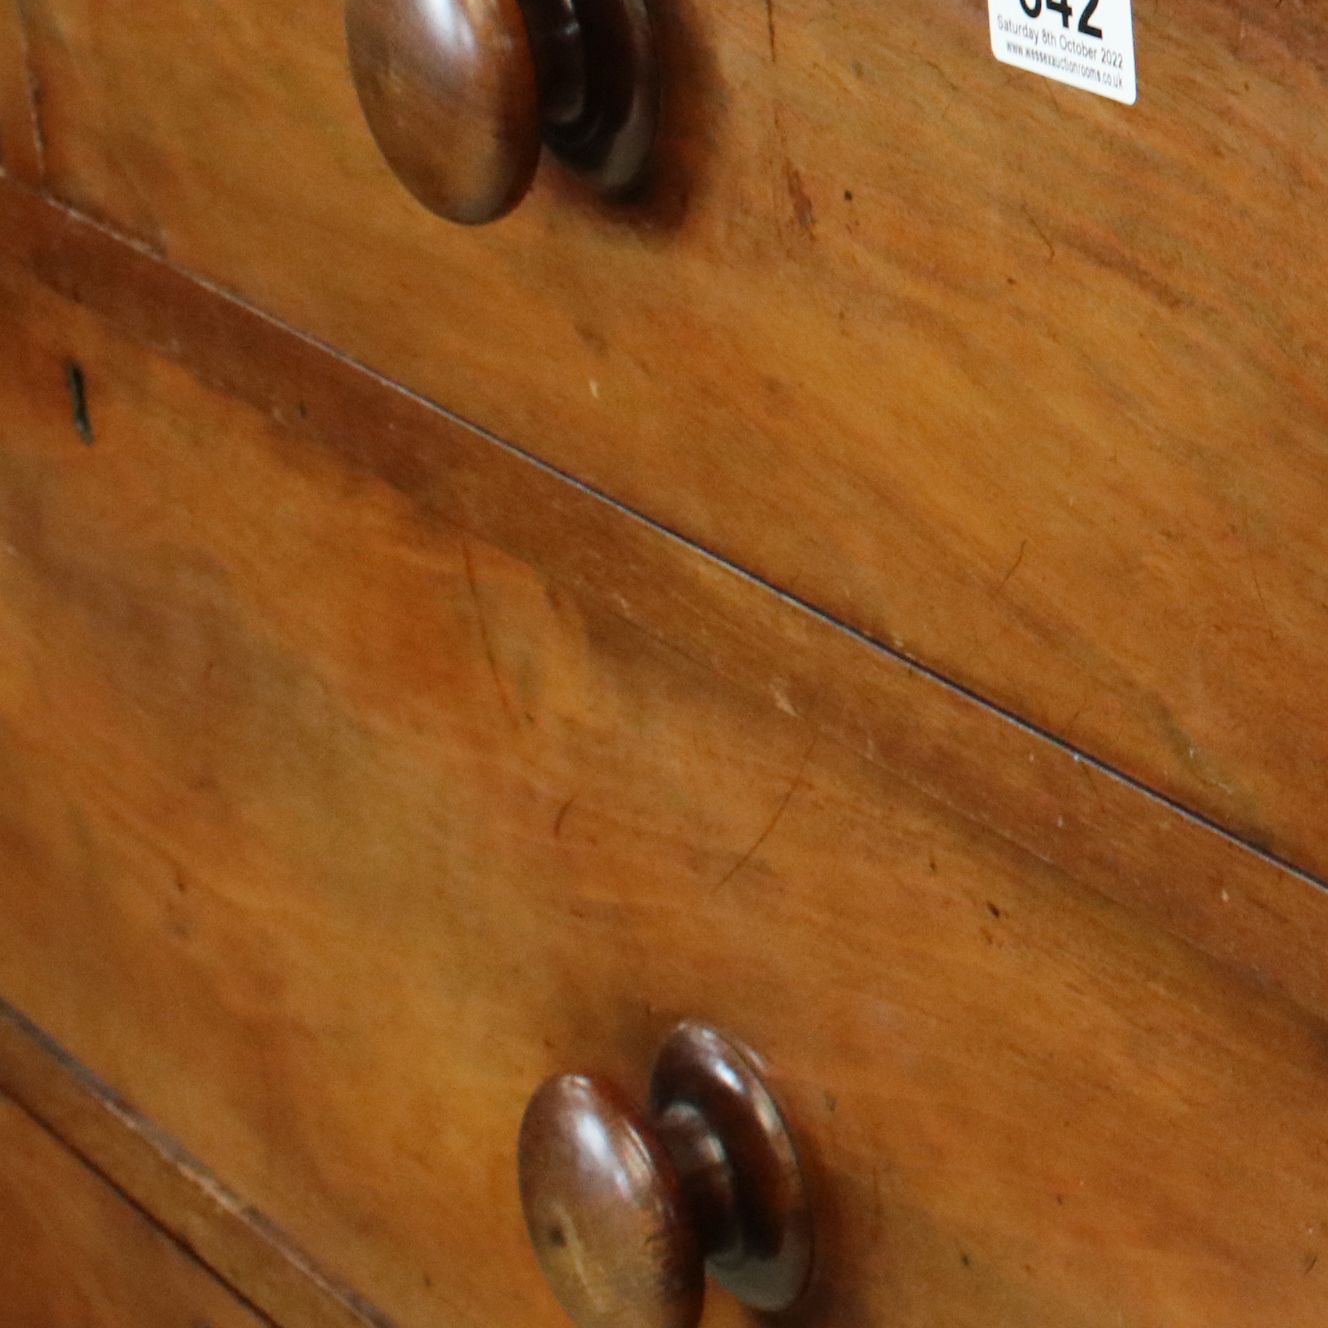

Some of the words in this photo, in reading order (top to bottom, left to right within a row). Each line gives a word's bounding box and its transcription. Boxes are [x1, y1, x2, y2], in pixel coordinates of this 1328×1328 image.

[997, 14, 1039, 45] Saturday
[1042, 29, 1057, 47] 8th
[1060, 35, 1098, 59] October
[1101, 48, 1123, 70] 2022
